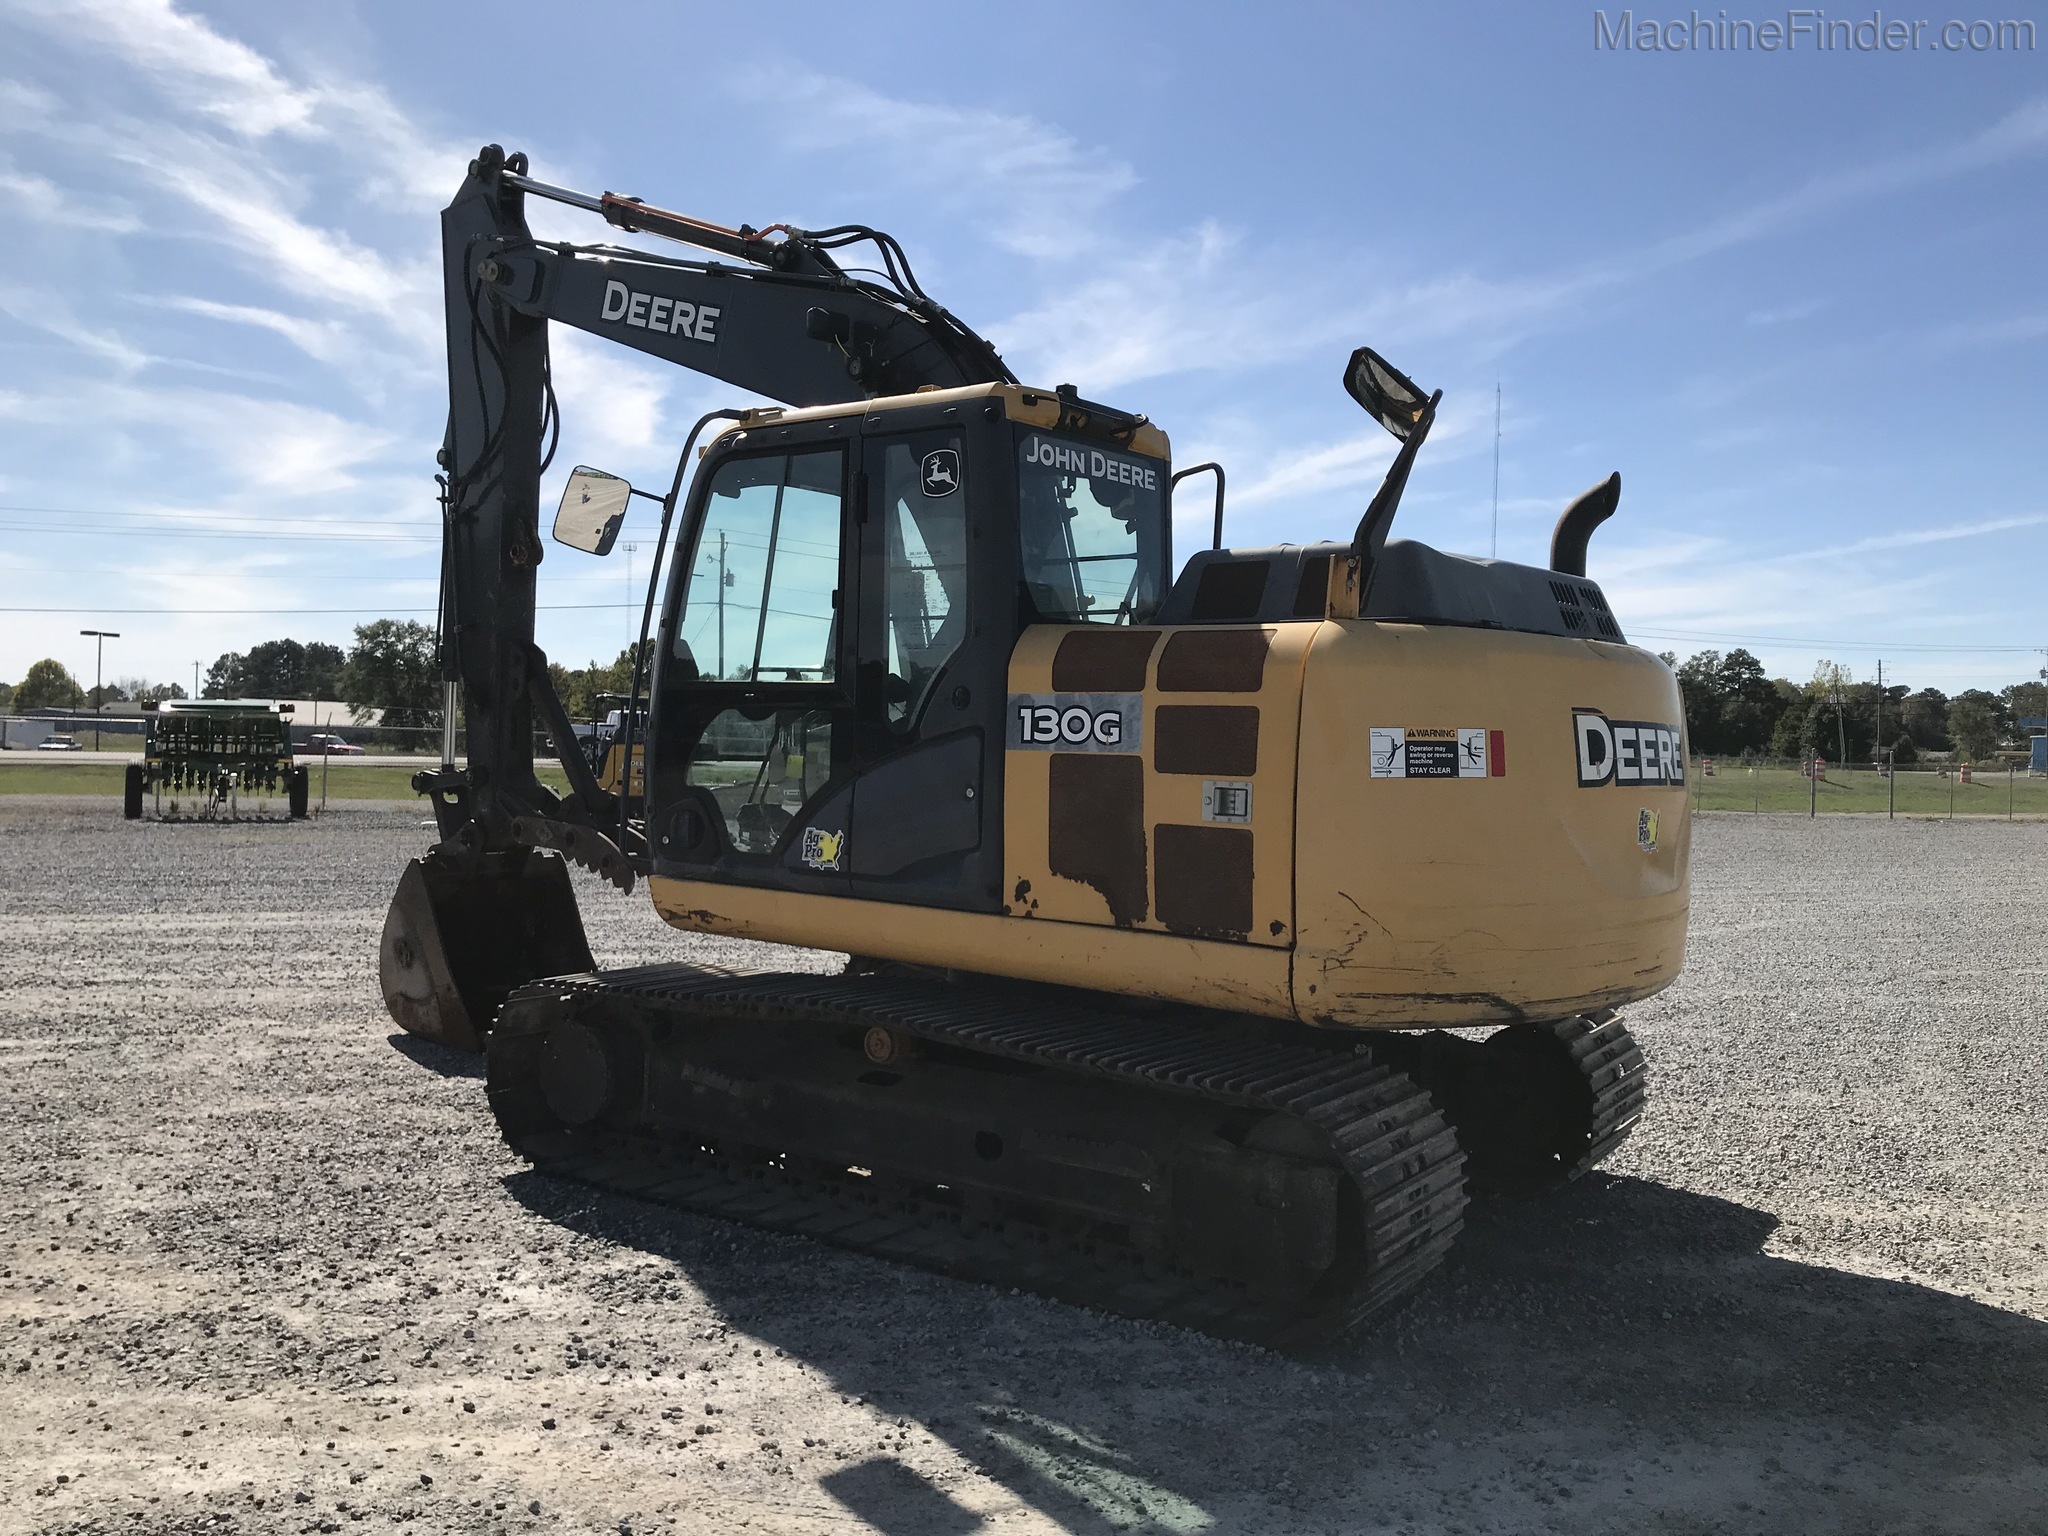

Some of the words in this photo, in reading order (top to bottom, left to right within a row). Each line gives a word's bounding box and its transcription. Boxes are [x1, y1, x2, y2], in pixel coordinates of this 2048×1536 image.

[601, 279, 721, 343] DEERE
[1026, 436, 1086, 474] JOHN
[1091, 450, 1156, 491] DEERE
[1018, 705, 1122, 745] 130G
[1416, 729, 1456, 738] WARNING
[1573, 710, 1684, 786] DEERE
[804, 844, 823, 858] Pro
